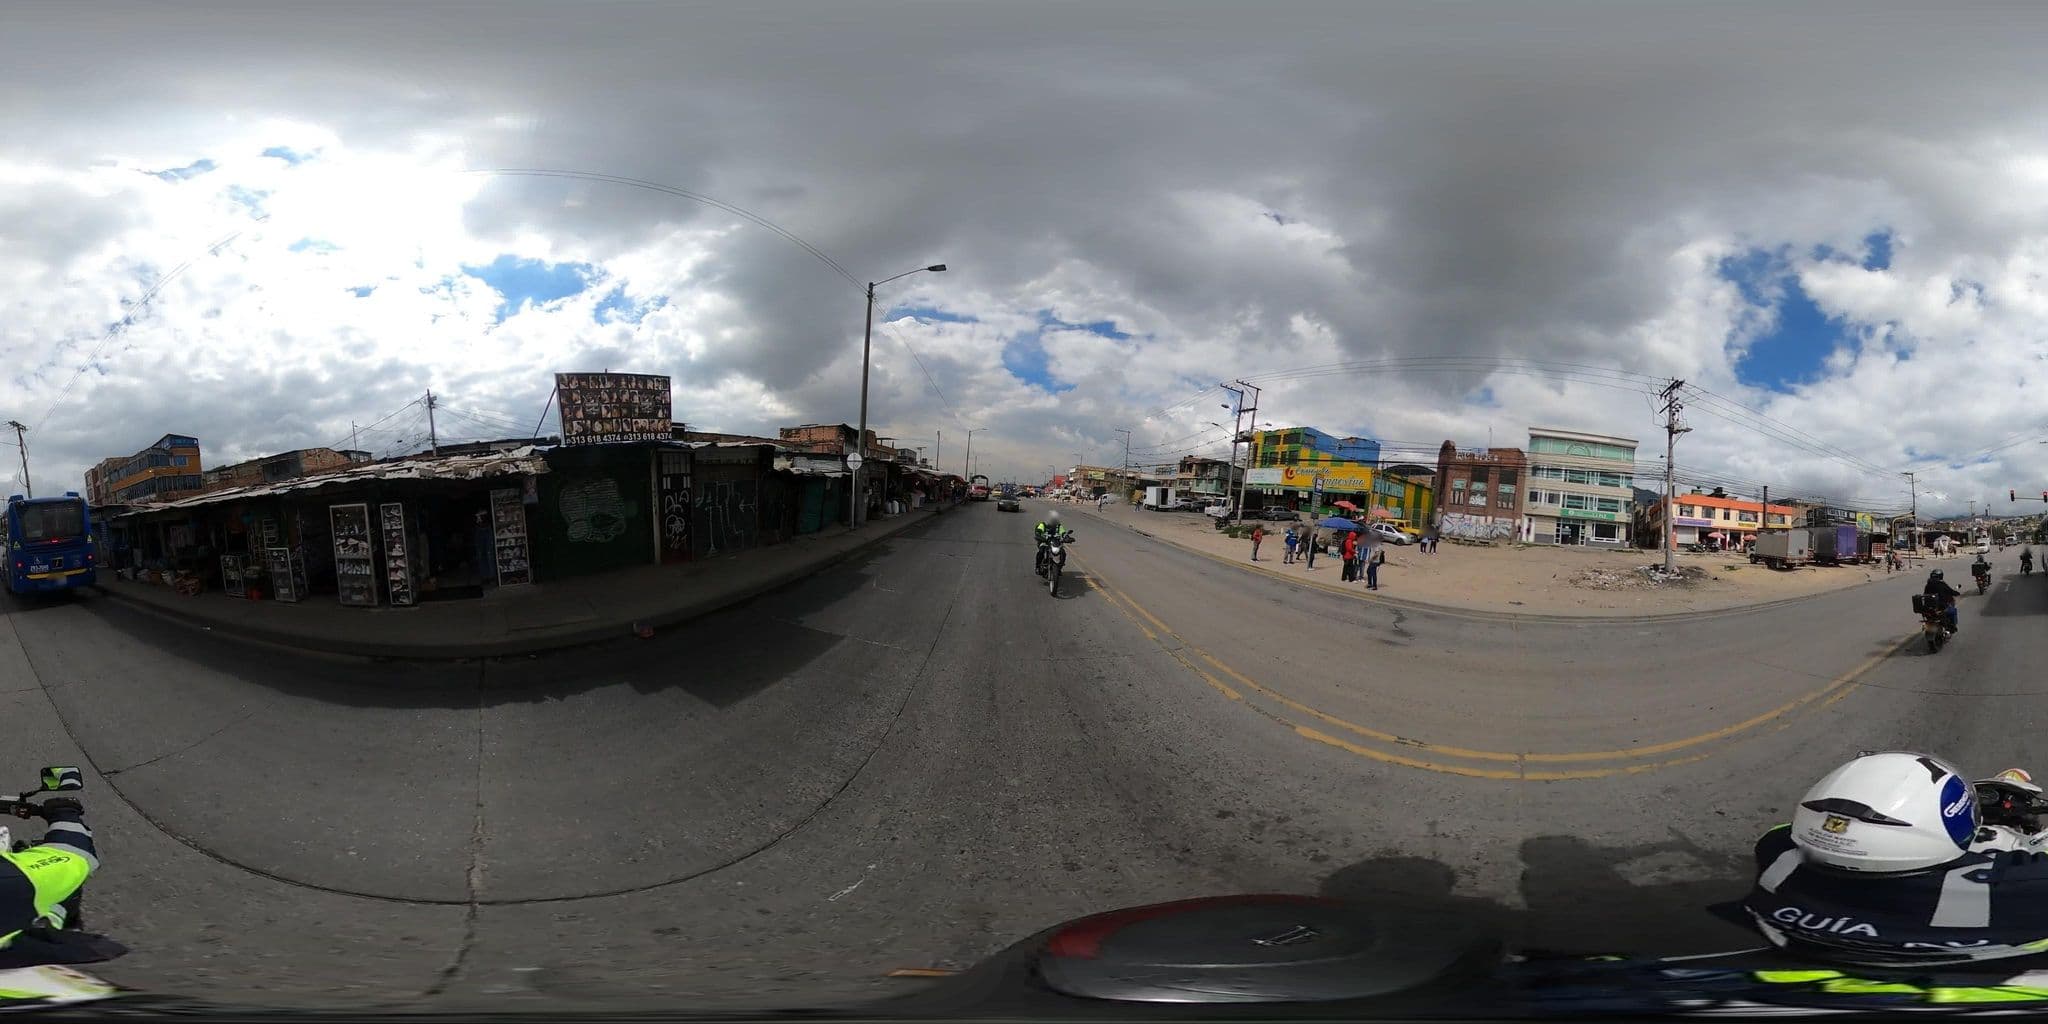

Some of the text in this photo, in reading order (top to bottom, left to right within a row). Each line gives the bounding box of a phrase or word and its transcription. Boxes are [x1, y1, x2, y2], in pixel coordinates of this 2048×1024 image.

[587, 435, 602, 443] 618
[602, 434, 621, 442] 4374
[628, 433, 641, 441] 313
[642, 432, 655, 440] 618
[656, 432, 673, 440] 4374
[1773, 906, 1880, 937] GUÍA
